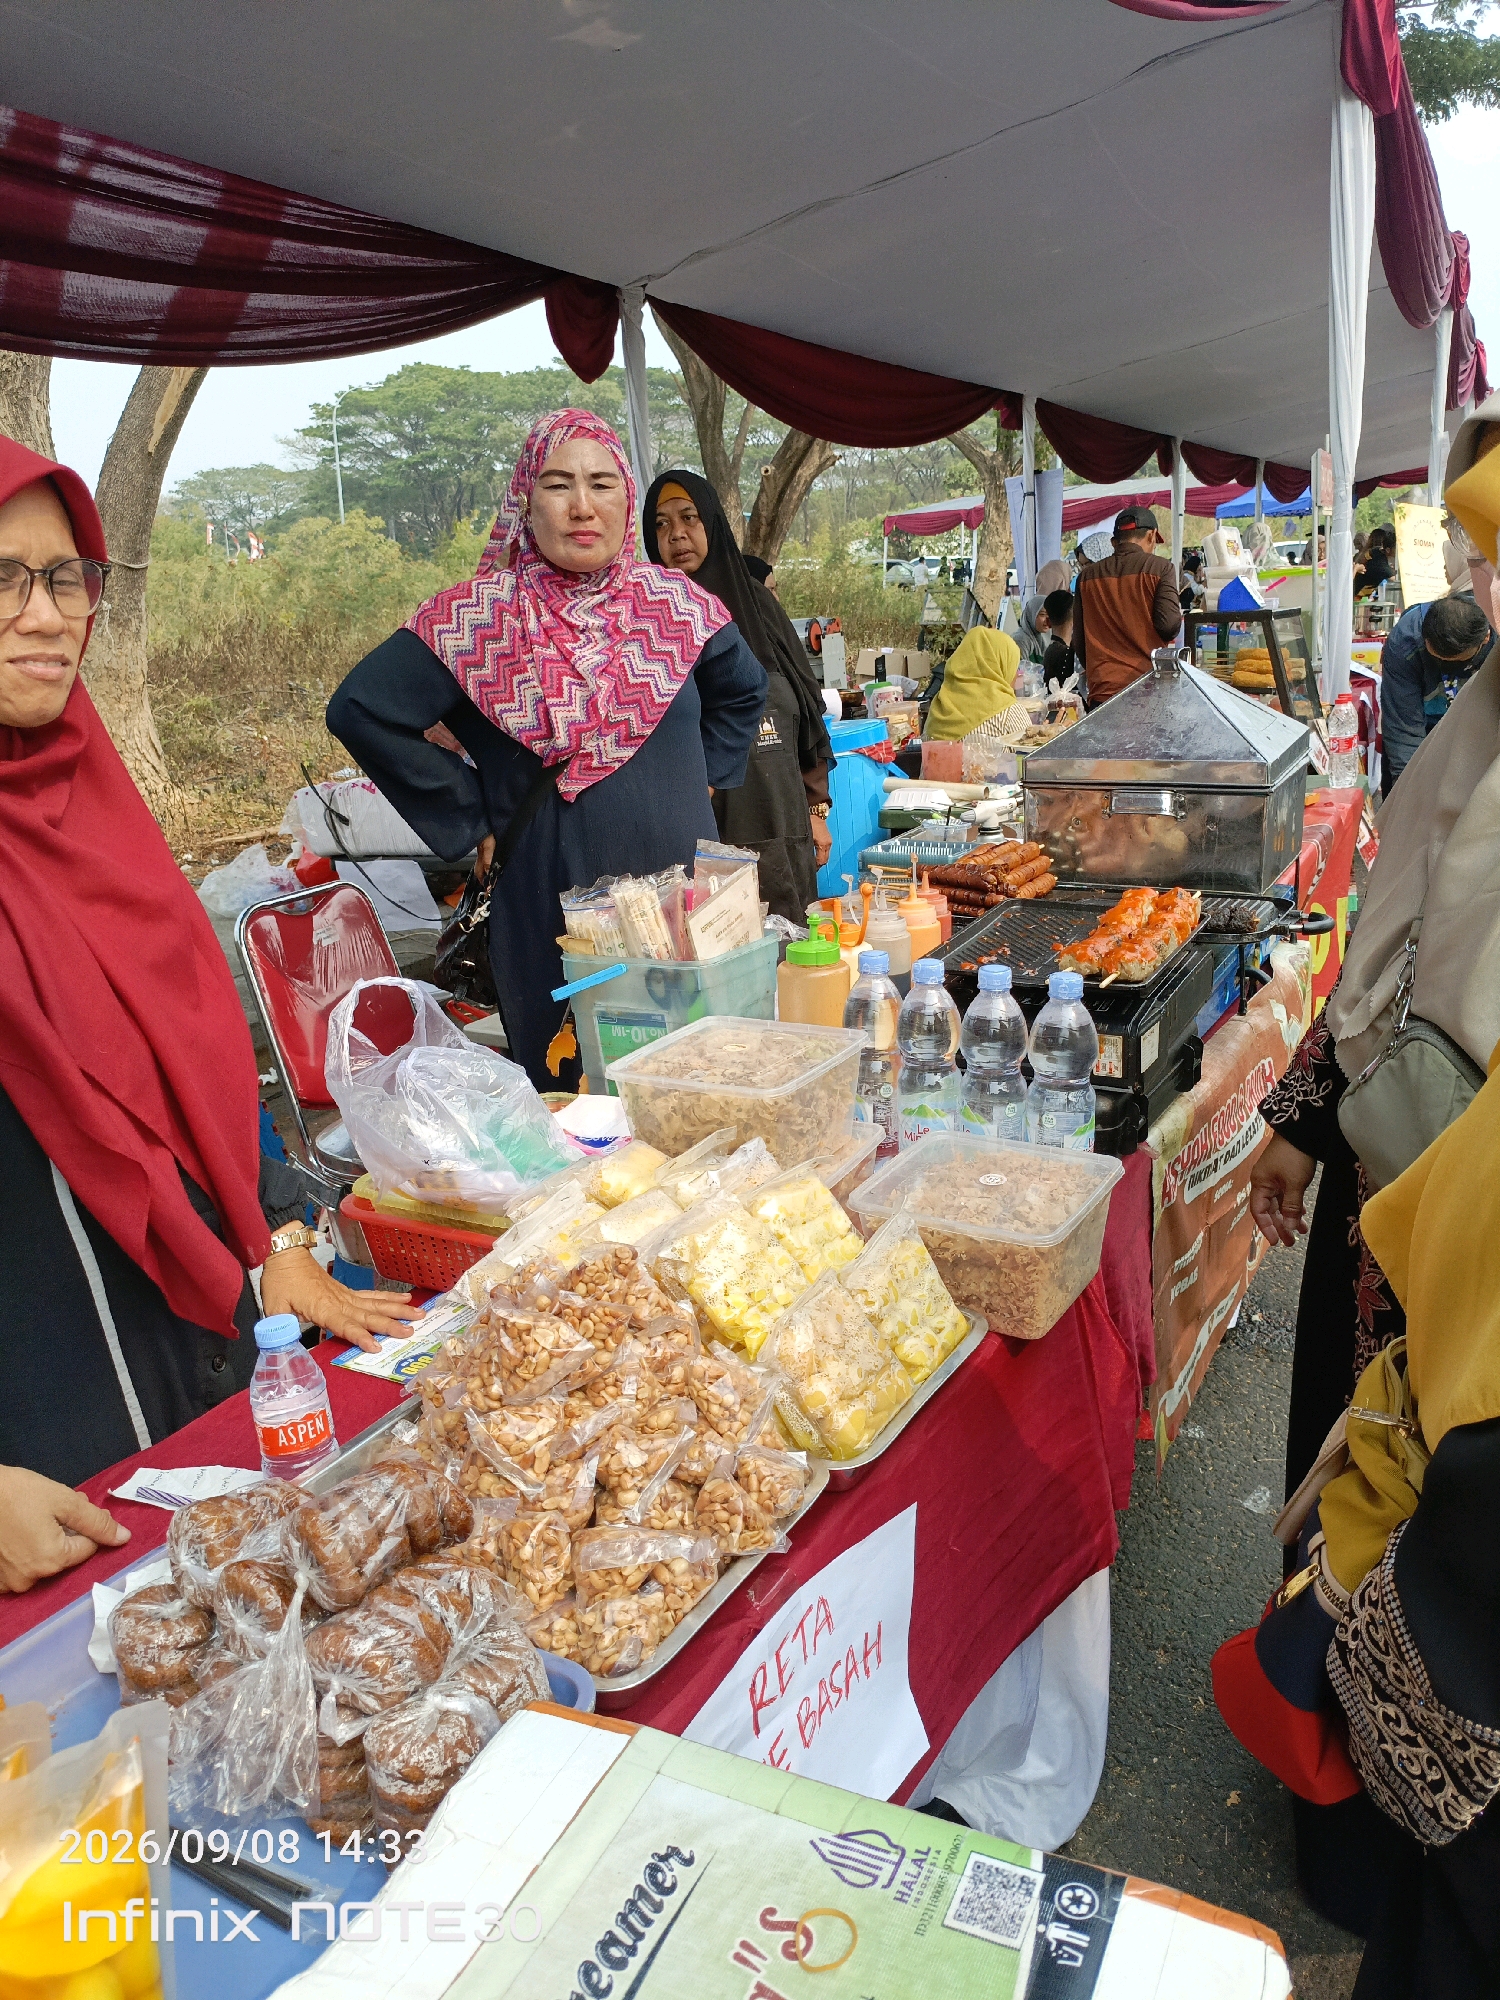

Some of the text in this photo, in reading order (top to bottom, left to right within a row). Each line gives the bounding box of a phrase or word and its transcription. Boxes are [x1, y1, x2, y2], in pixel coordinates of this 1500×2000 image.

[916, 1123, 930, 1135] Le
[1210, 1092, 1238, 1151] FOOD
[278, 1413, 325, 1447] ASPEN
[748, 1594, 835, 1739] RETA
[796, 1620, 884, 1750] BASAH
[892, 1845, 932, 1906] HALAL
[911, 1848, 942, 1909] INDONESIA
[568, 1844, 696, 2000] eamer
